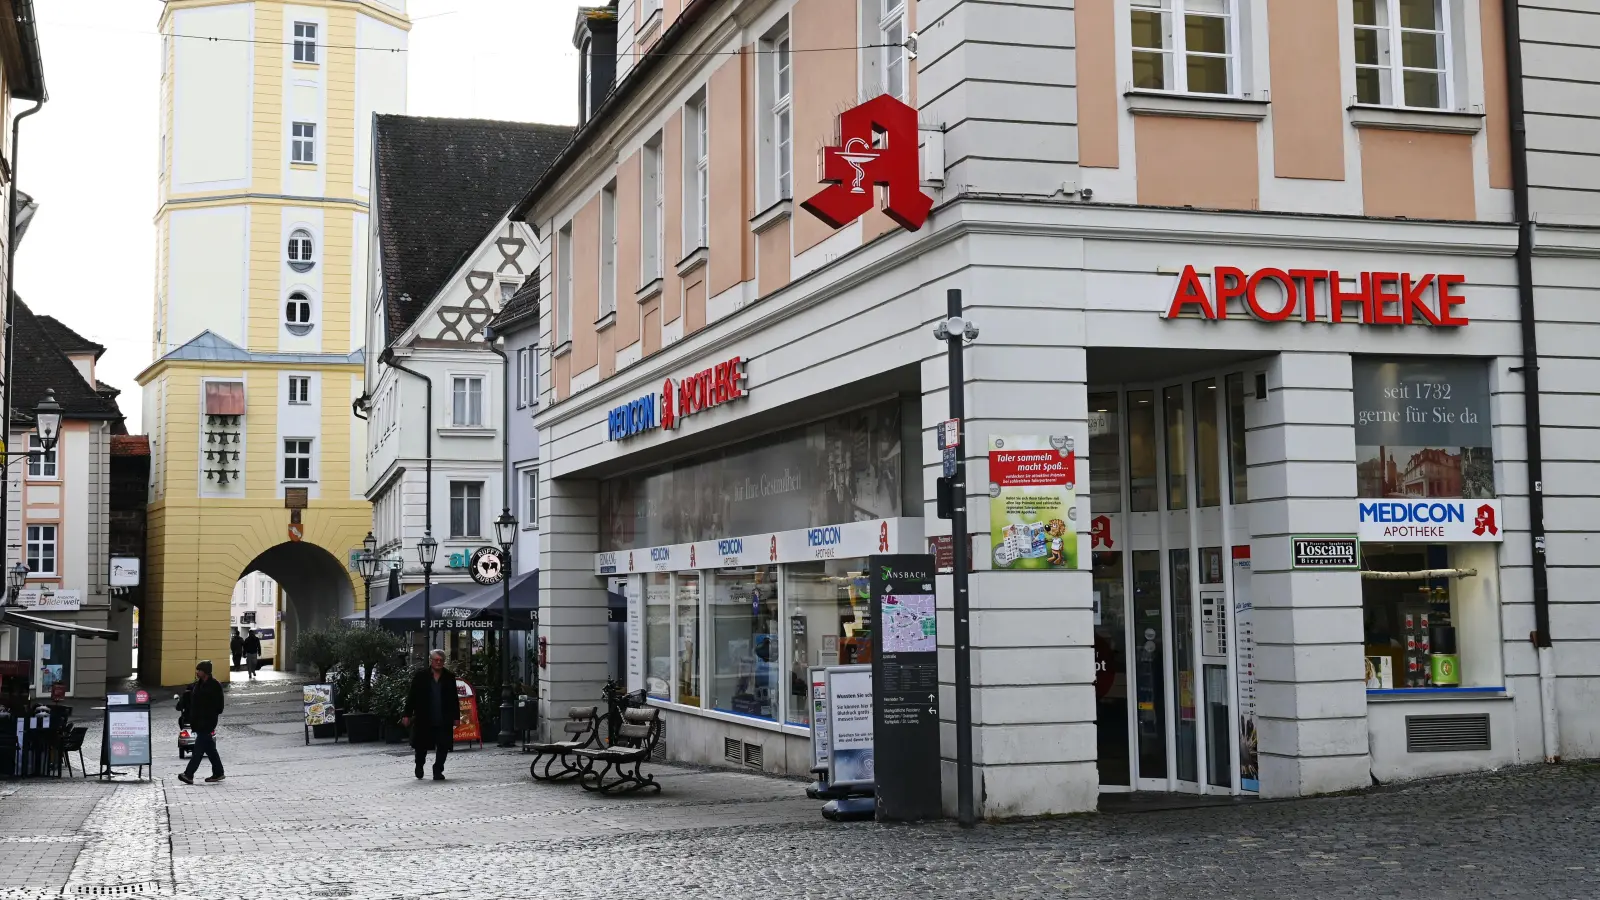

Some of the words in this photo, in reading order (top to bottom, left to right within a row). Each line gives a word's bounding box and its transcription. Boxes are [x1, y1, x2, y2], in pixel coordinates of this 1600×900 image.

[1167, 264, 1469, 326] APOTHEKE
[608, 392, 655, 441] MEDICON
[679, 355, 742, 417] APOTHEKE
[1384, 382, 1409, 399] seit
[1415, 383, 1452, 400] 1732
[1358, 409, 1401, 425] gerne
[1405, 405, 1428, 424] für
[1432, 406, 1457, 424] Sie
[1459, 407, 1479, 425] da
[997, 454, 1016, 463] Taler
[1017, 453, 1052, 462] sammeln
[1018, 463, 1042, 472] macht
[1359, 502, 1465, 523] MEDICON
[808, 526, 841, 547] MEDICON
[1383, 526, 1445, 537] APOTHEKE
[718, 538, 743, 556] MEDICON
[1296, 541, 1354, 556] Toscana
[475, 572, 504, 584] BURGER
[886, 569, 926, 579] ANSBACH
[38, 592, 80, 606] Bilderwelt
[420, 619, 453, 629] RUFF'S
[455, 619, 494, 629] BURGER
